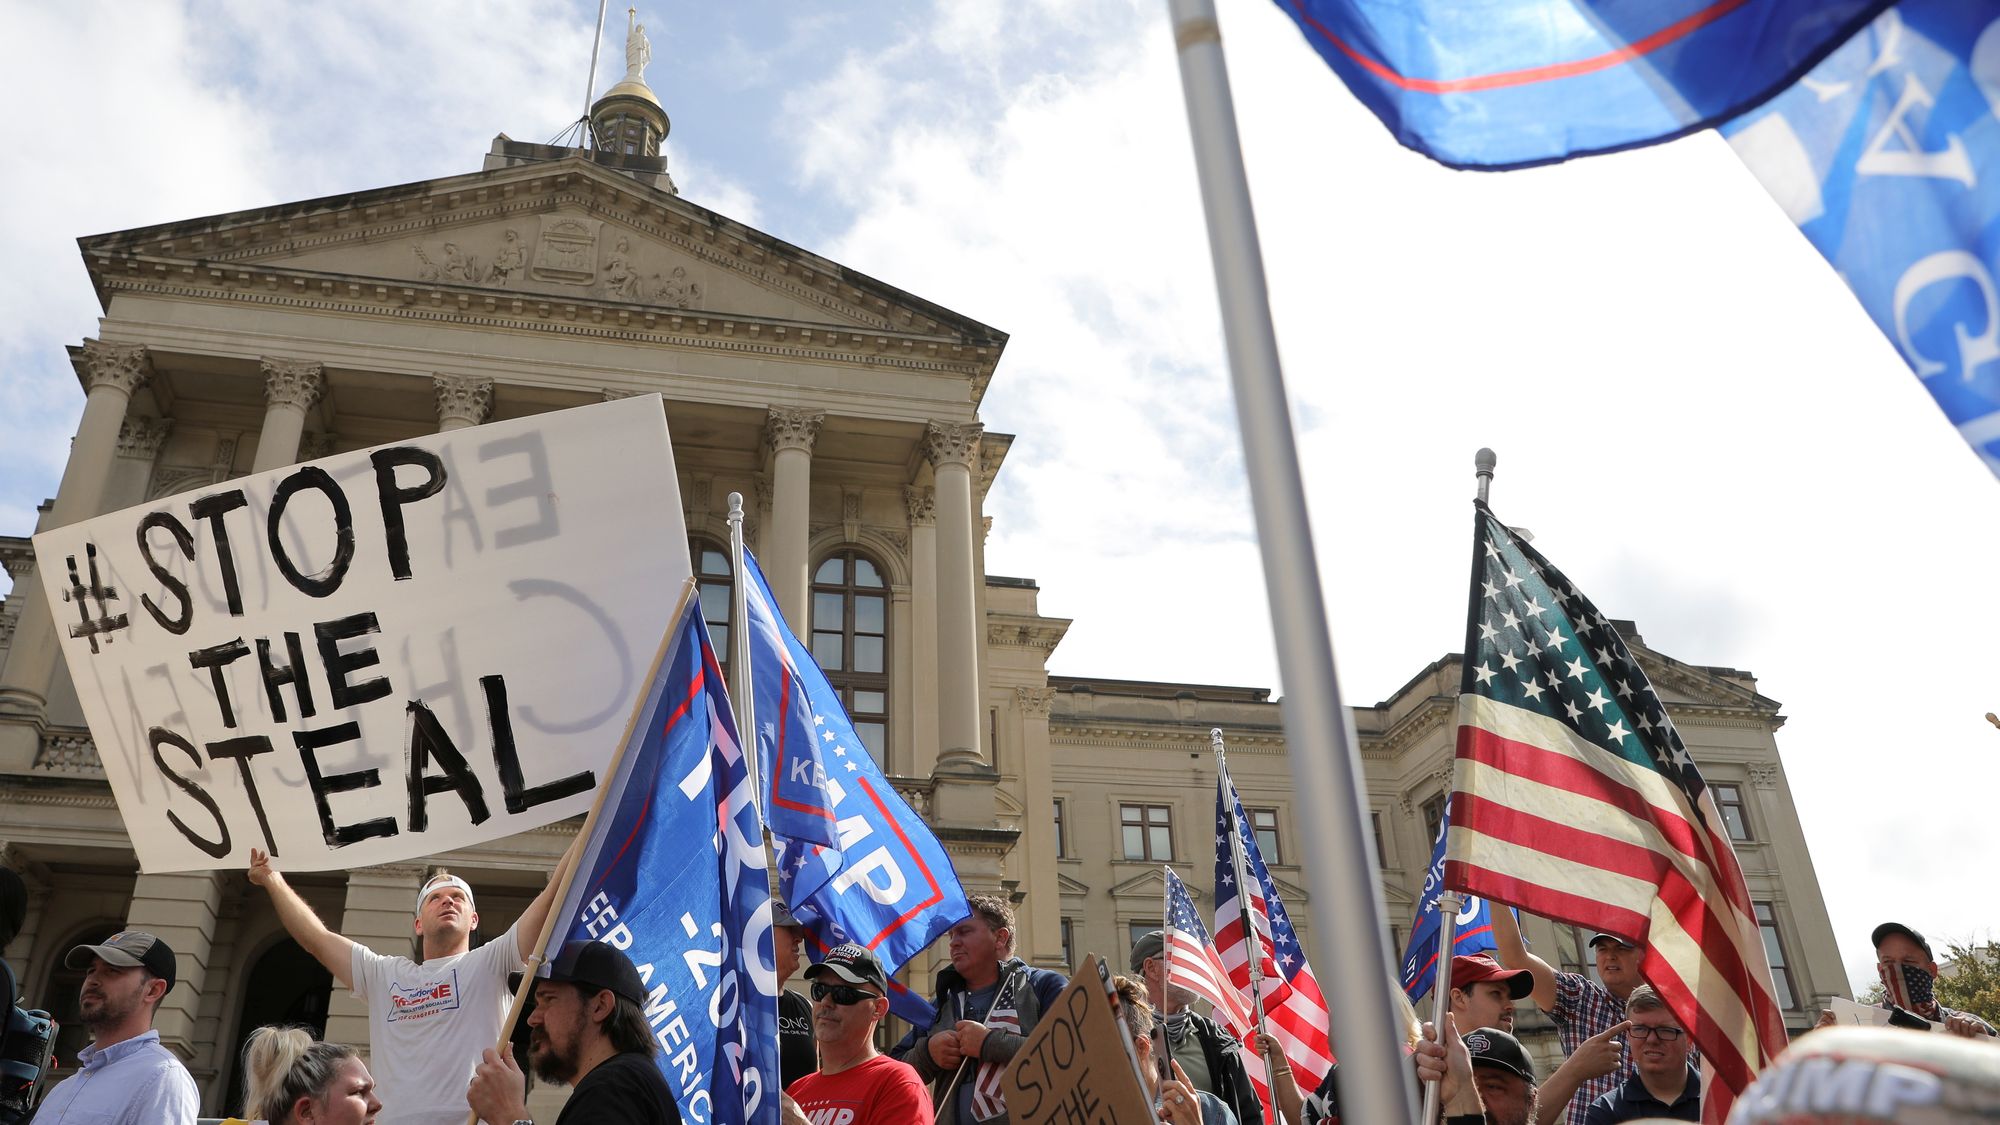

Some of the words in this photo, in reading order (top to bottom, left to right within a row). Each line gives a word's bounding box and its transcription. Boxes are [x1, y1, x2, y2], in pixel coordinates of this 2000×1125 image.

[62, 445, 449, 654] #STOP
[188, 611, 393, 729] THE
[147, 674, 596, 859] STEAL
[789, 756, 829, 792] KE
[579, 890, 634, 951] EEP
[1015, 985, 1090, 1120] STOP
[1043, 1067, 1100, 1125] THE
